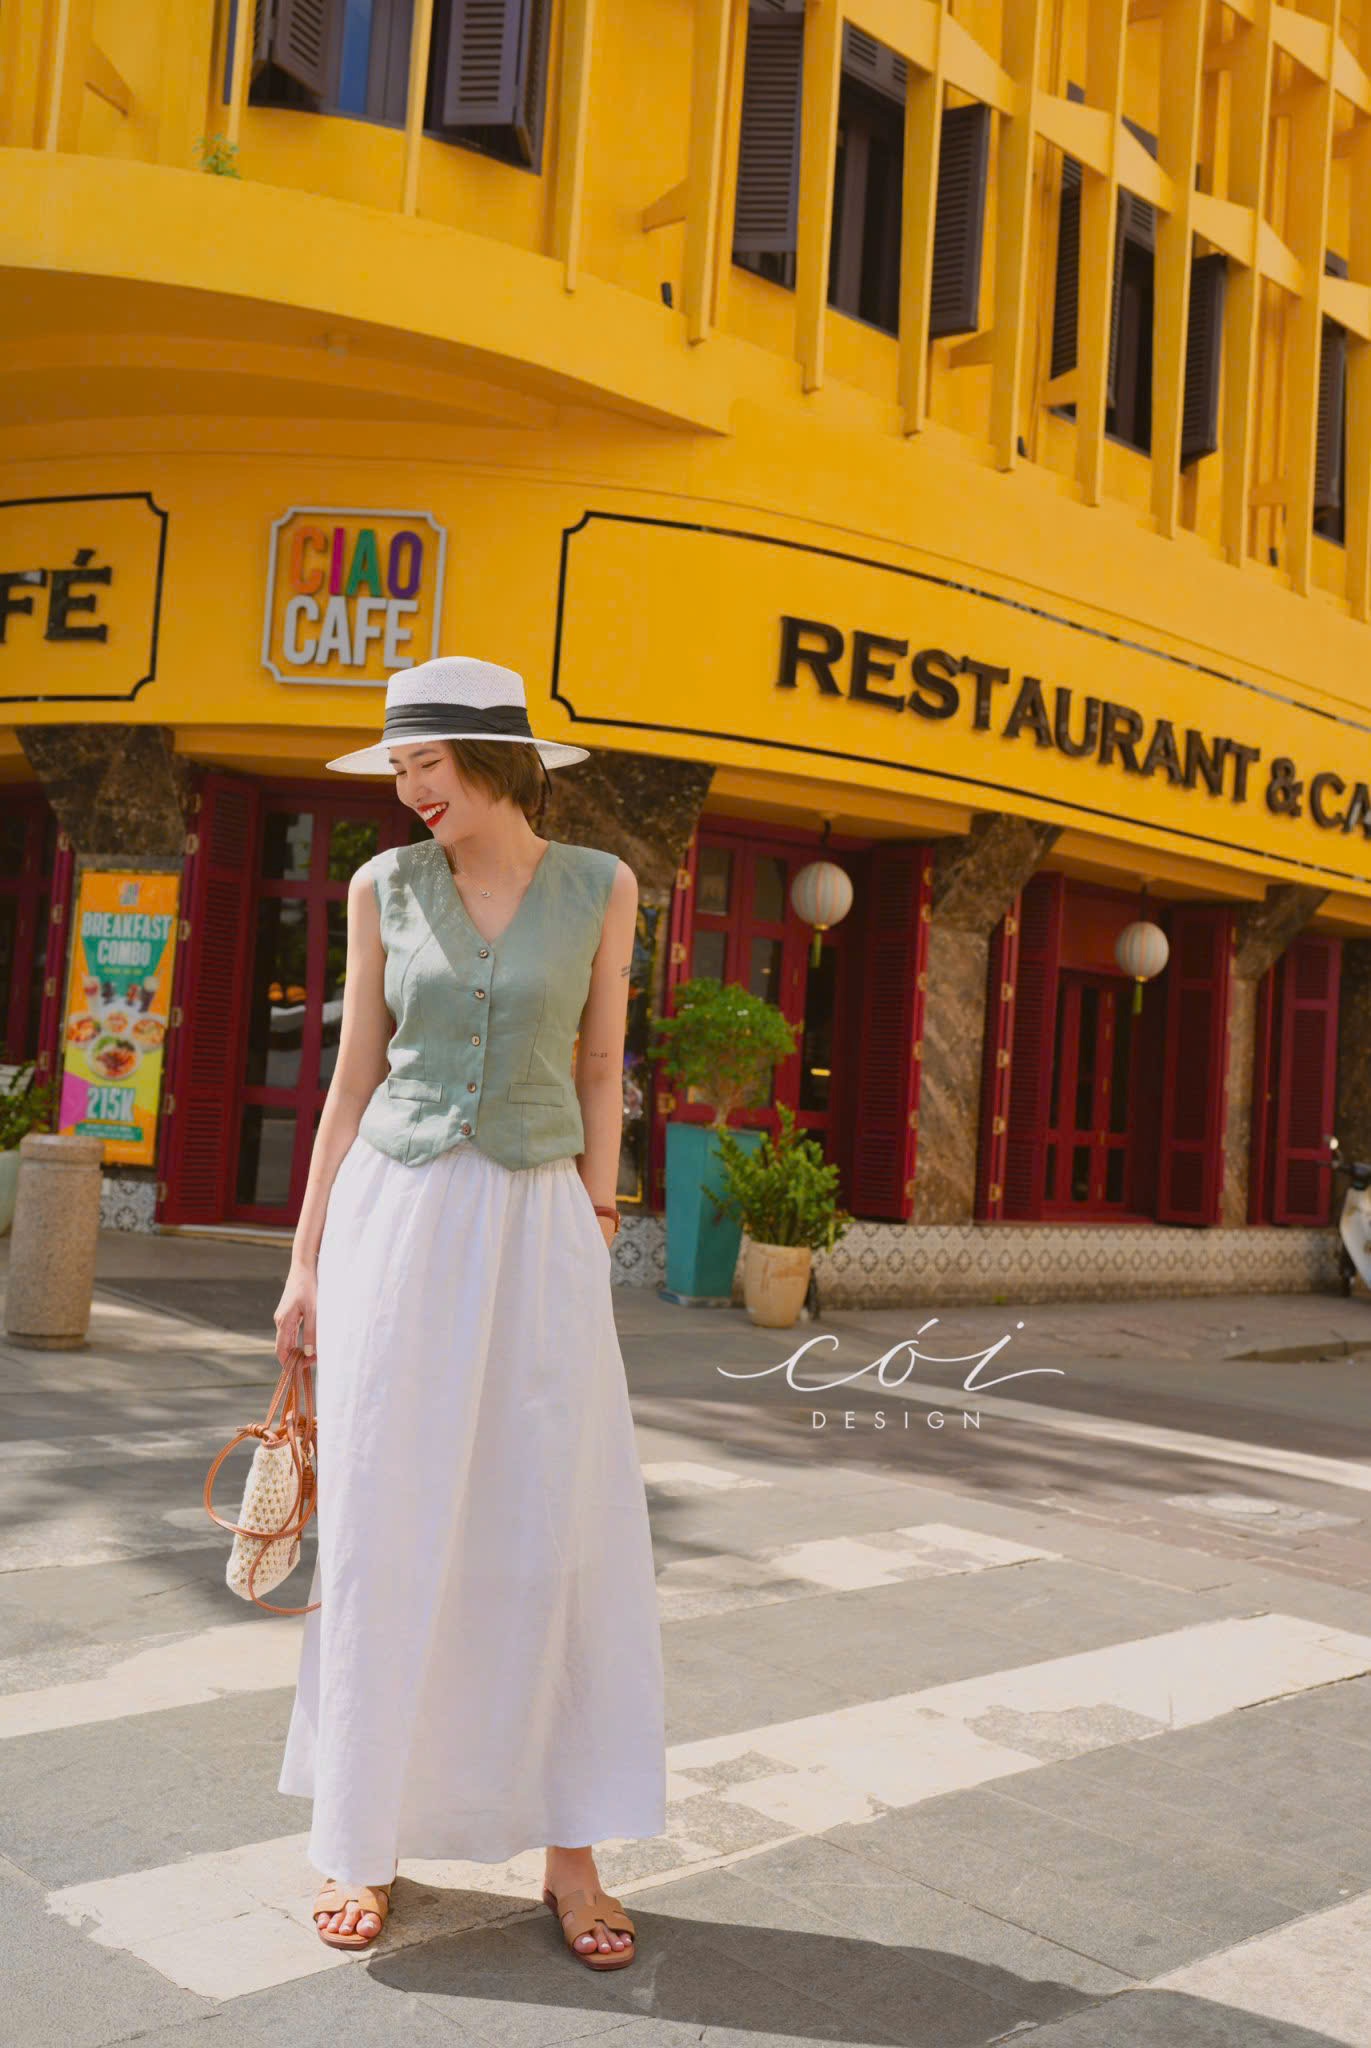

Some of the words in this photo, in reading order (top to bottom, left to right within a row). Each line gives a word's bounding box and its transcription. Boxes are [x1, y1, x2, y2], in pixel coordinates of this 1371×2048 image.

[290, 527, 423, 599] CIAO
[283, 594, 418, 668] CAFE
[776, 615, 1260, 803] RESTAURANT
[1266, 757, 1303, 817] &
[82, 911, 173, 941] BREAKFAST
[97, 939, 152, 967] COMBO
